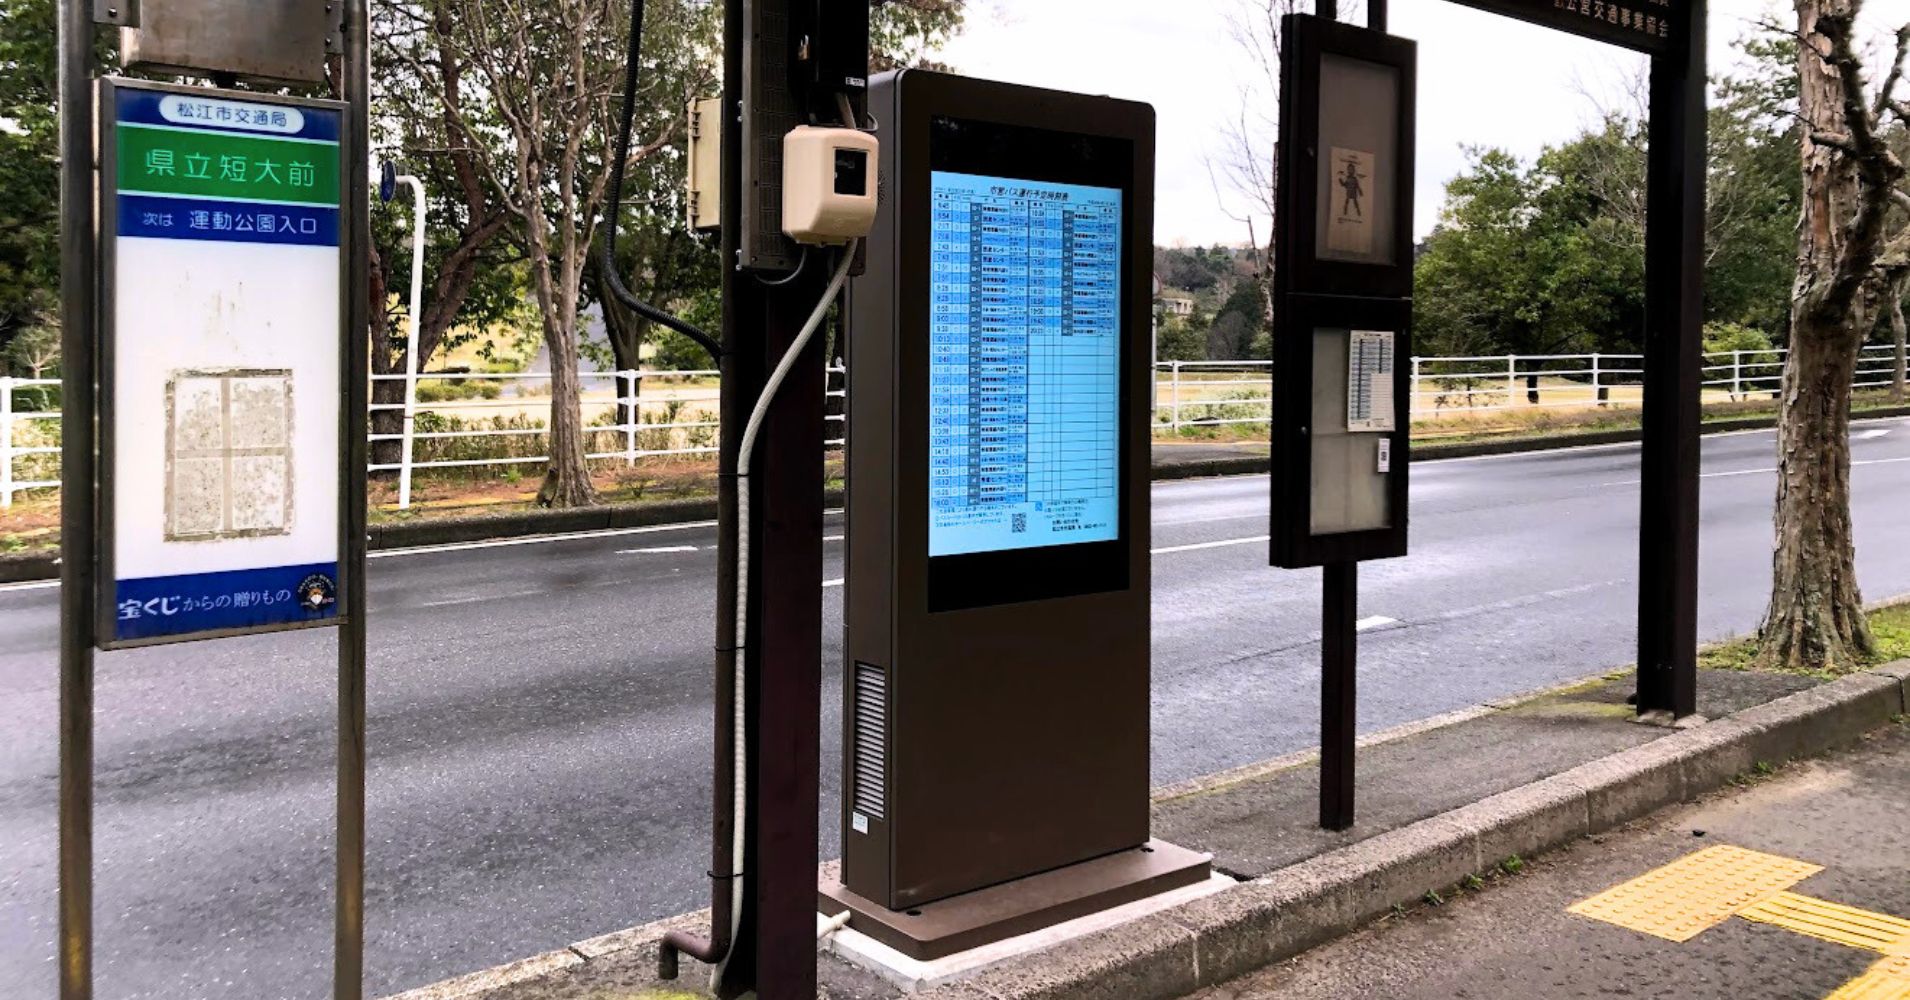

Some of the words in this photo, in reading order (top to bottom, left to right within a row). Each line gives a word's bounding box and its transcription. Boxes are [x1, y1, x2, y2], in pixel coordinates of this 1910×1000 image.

[177, 102, 288, 127] 松江市交通局
[145, 148, 315, 188] 県立短大前
[142, 211, 174, 227] 次は
[189, 210, 317, 235] 運動公園入口
[117, 588, 292, 621] 宝くじからの贈りもの
